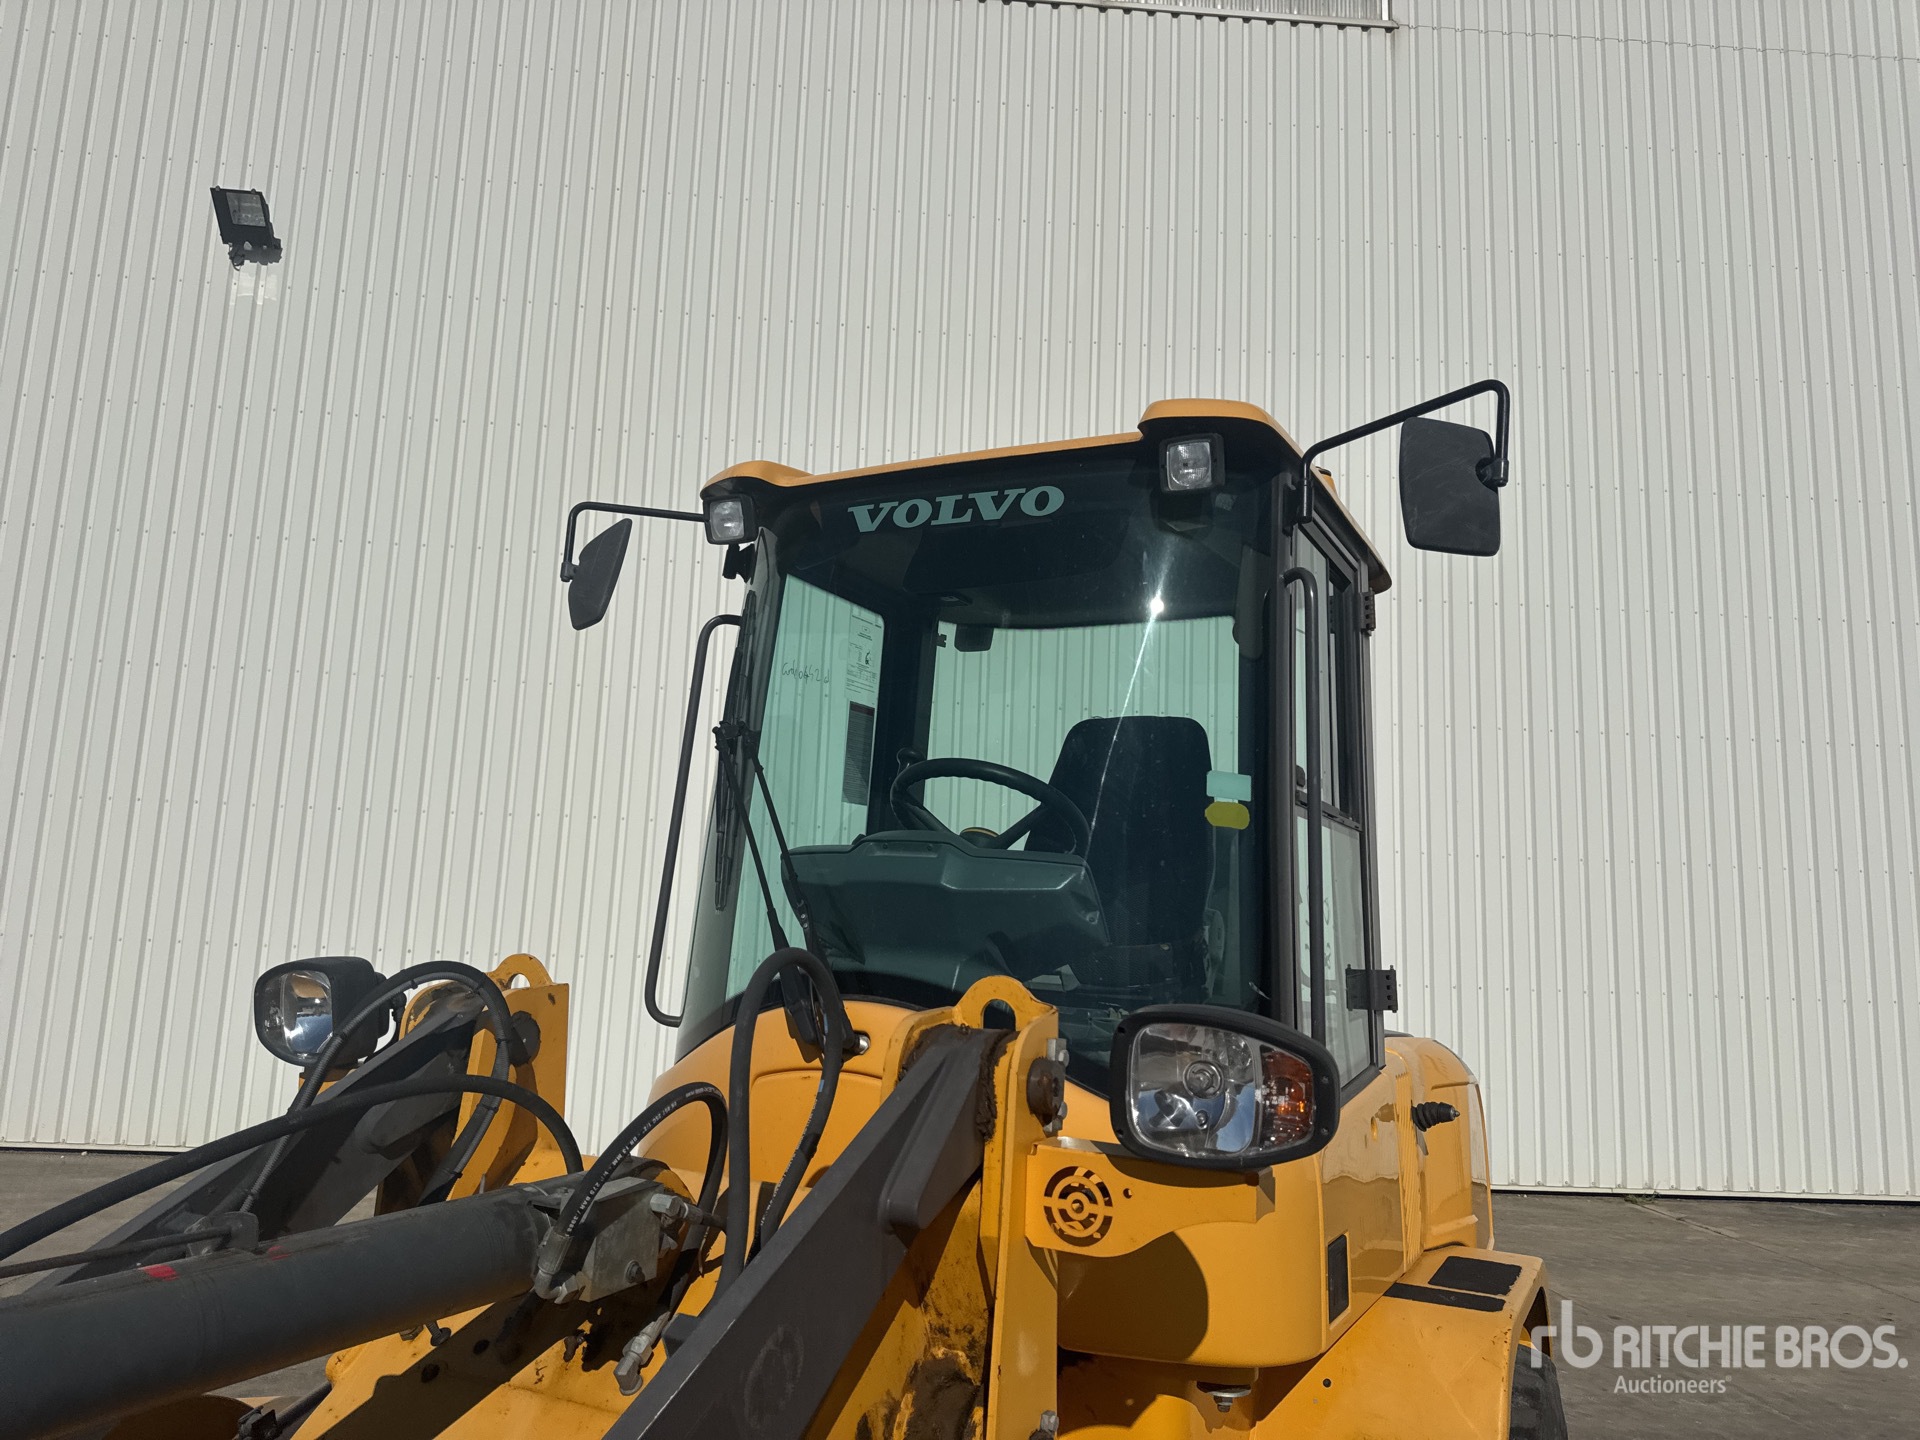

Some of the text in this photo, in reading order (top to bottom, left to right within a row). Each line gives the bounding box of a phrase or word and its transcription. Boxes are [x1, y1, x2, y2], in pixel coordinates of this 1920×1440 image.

[847, 485, 1065, 533] VOLVO
[612, 1153, 623, 1167] MM
[579, 1195, 591, 1211] BAR
